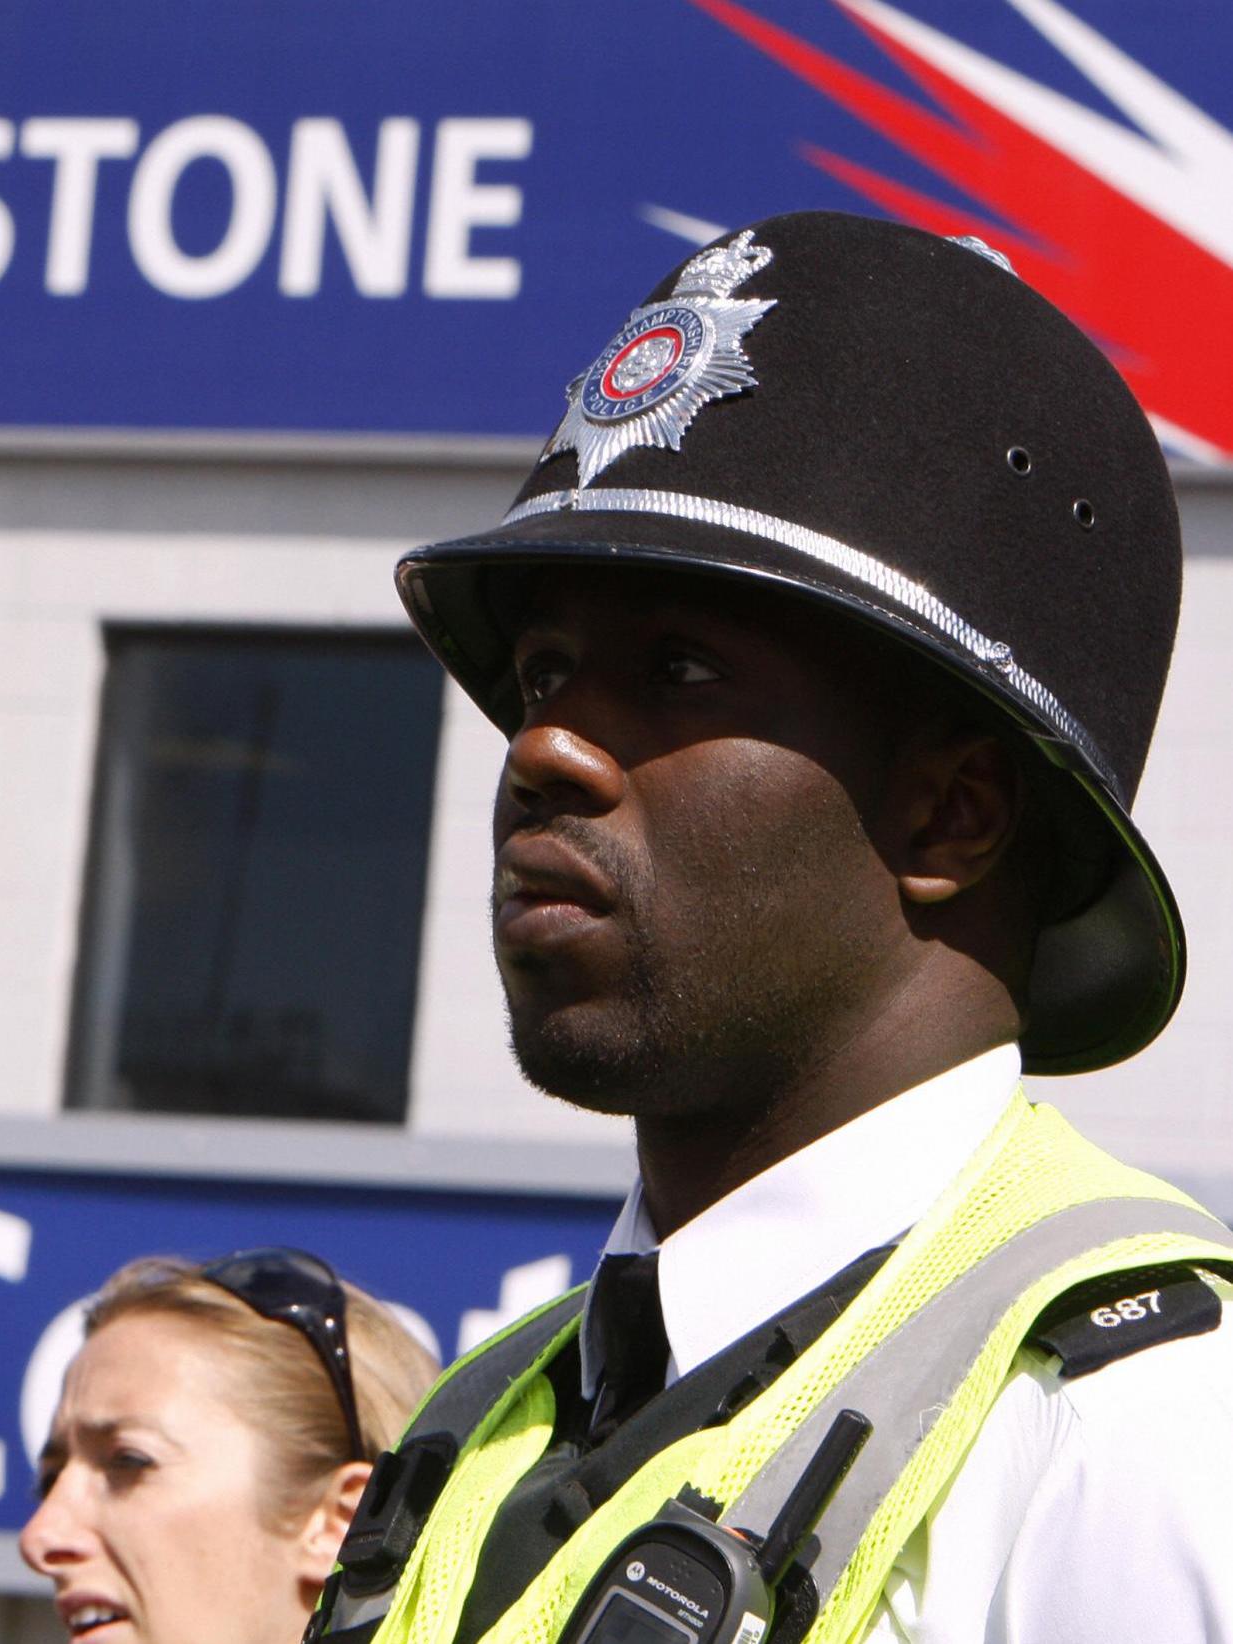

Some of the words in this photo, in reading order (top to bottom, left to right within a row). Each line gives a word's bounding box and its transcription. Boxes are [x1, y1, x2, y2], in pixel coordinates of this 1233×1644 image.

[590, 391, 653, 414] POLICE
[1090, 1290, 1162, 1328] 687
[647, 1576, 709, 1619] MOTOROLA
